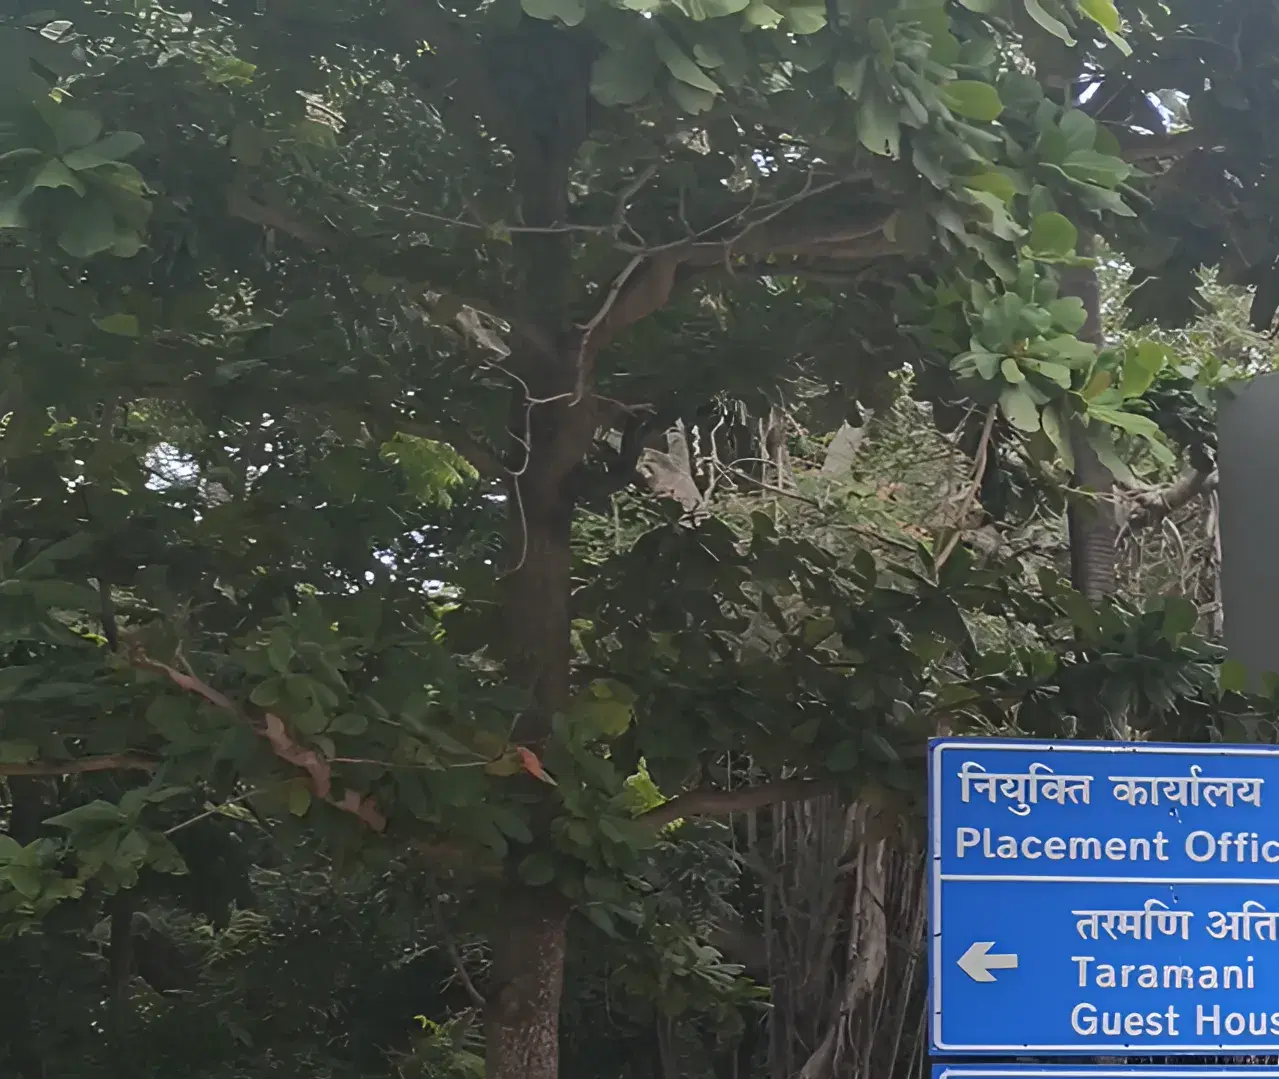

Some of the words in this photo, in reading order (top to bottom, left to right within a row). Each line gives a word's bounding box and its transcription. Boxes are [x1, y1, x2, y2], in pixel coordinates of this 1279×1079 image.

[957, 761, 1094, 816] नियुक्ति
[1108, 764, 1265, 811] कार्यालय
[956, 827, 1169, 861] Placement
[1071, 898, 1194, 941] तरमणि
[1071, 955, 1255, 989] Taramani
[1071, 1002, 1180, 1036] Guest
